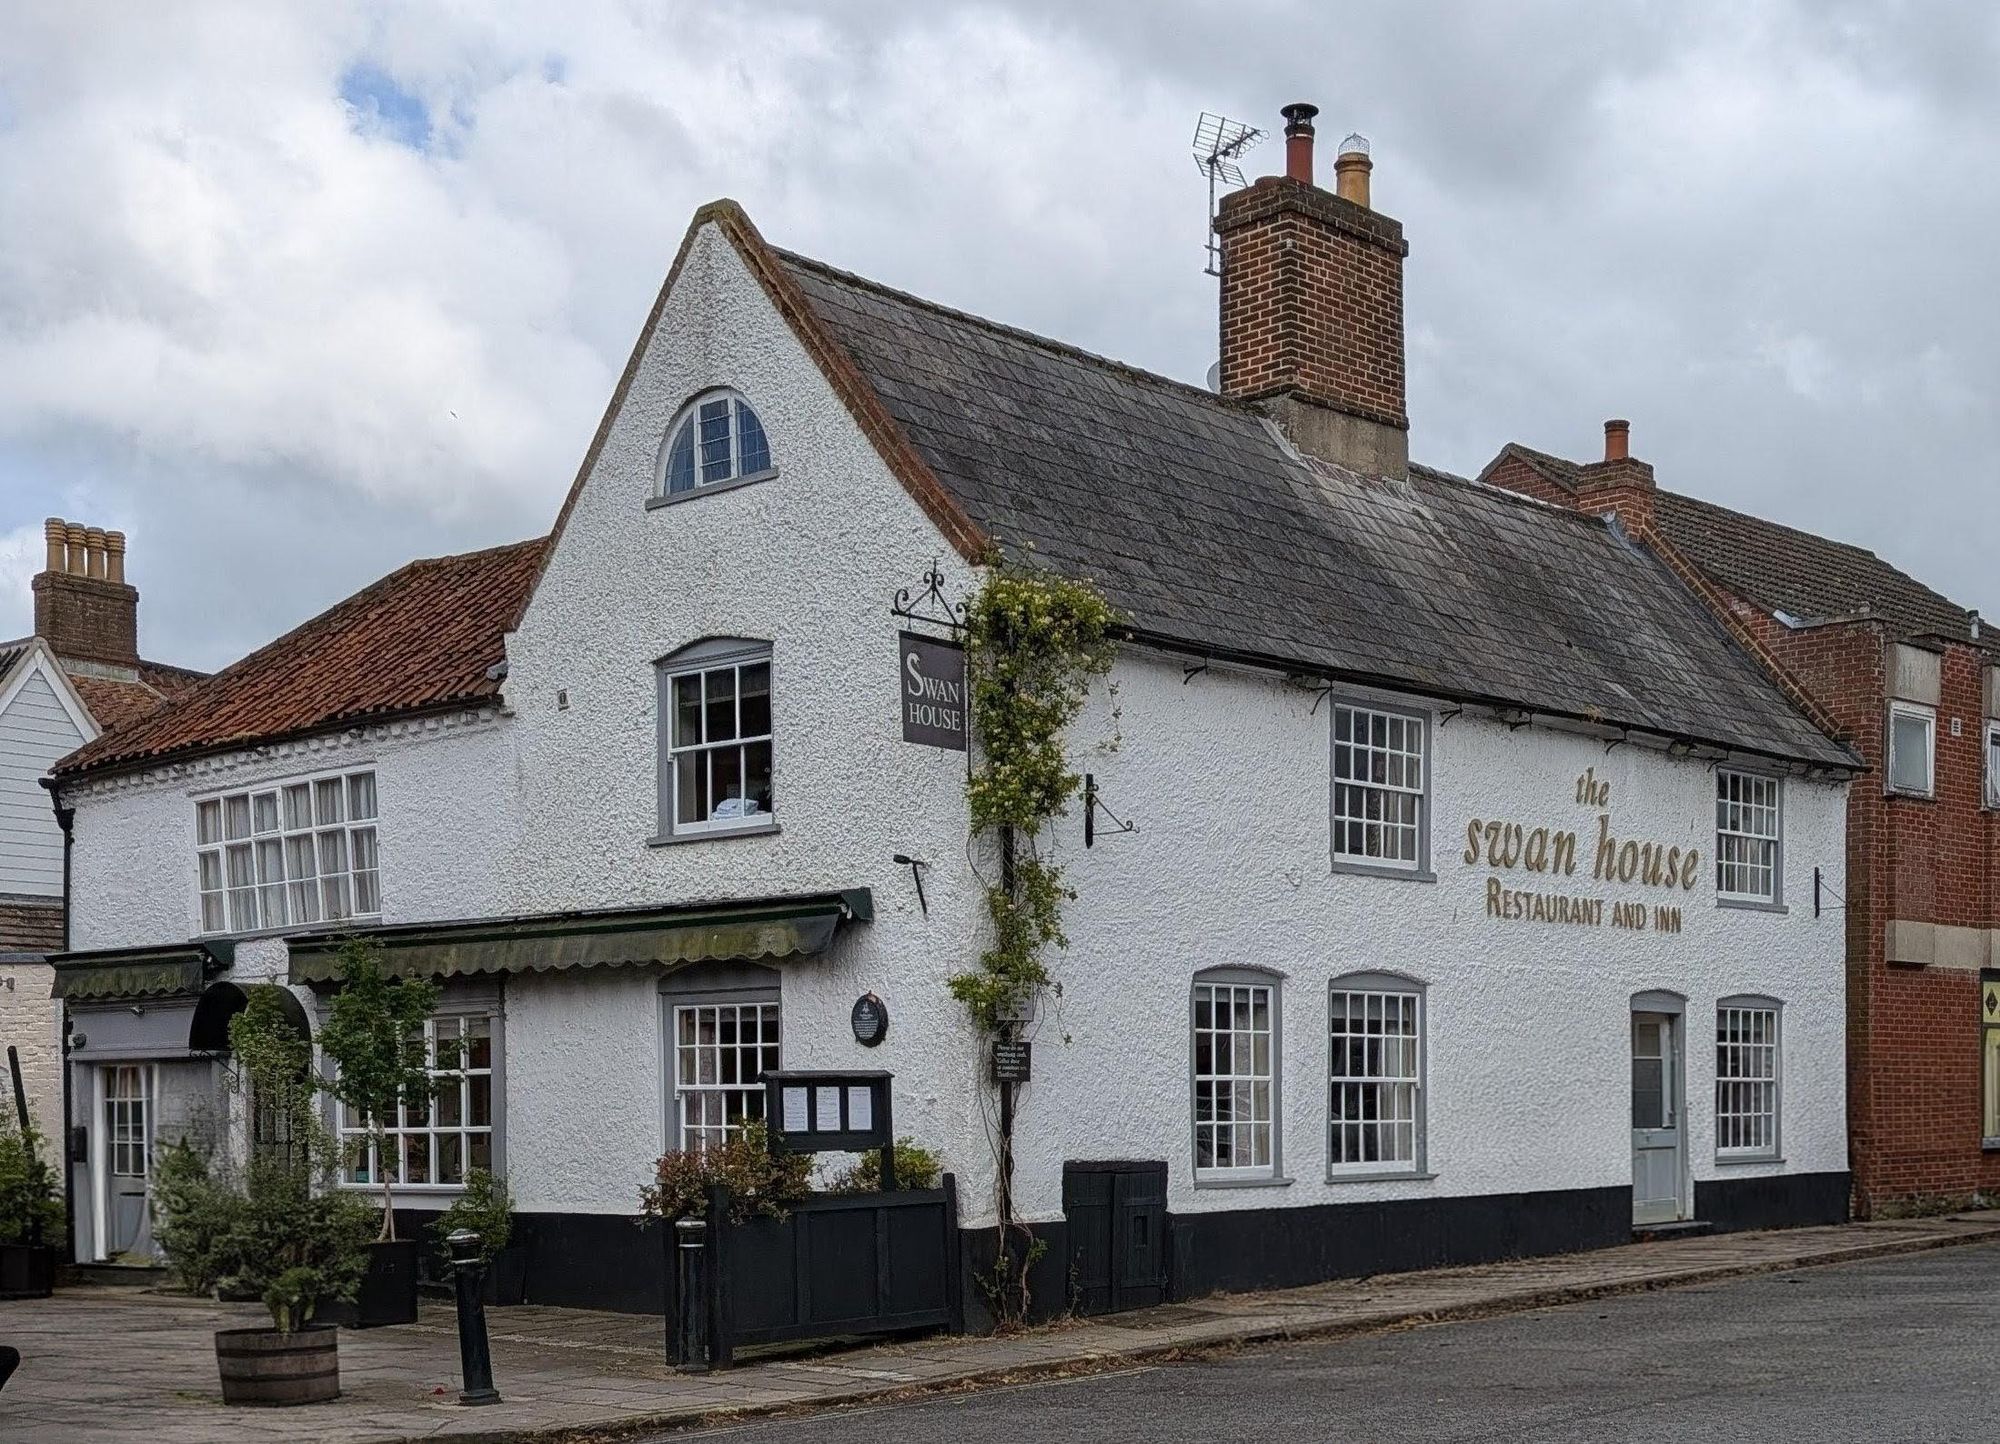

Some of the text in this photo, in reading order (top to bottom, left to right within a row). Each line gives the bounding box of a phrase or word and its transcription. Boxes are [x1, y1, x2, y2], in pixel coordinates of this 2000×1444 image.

[907, 652, 960, 704] SWAN
[909, 703, 961, 731] HOUSE
[1576, 767, 1610, 806] the
[1464, 814, 1699, 890] swan house
[1486, 876, 1682, 933] RESTAURANT AND INN
